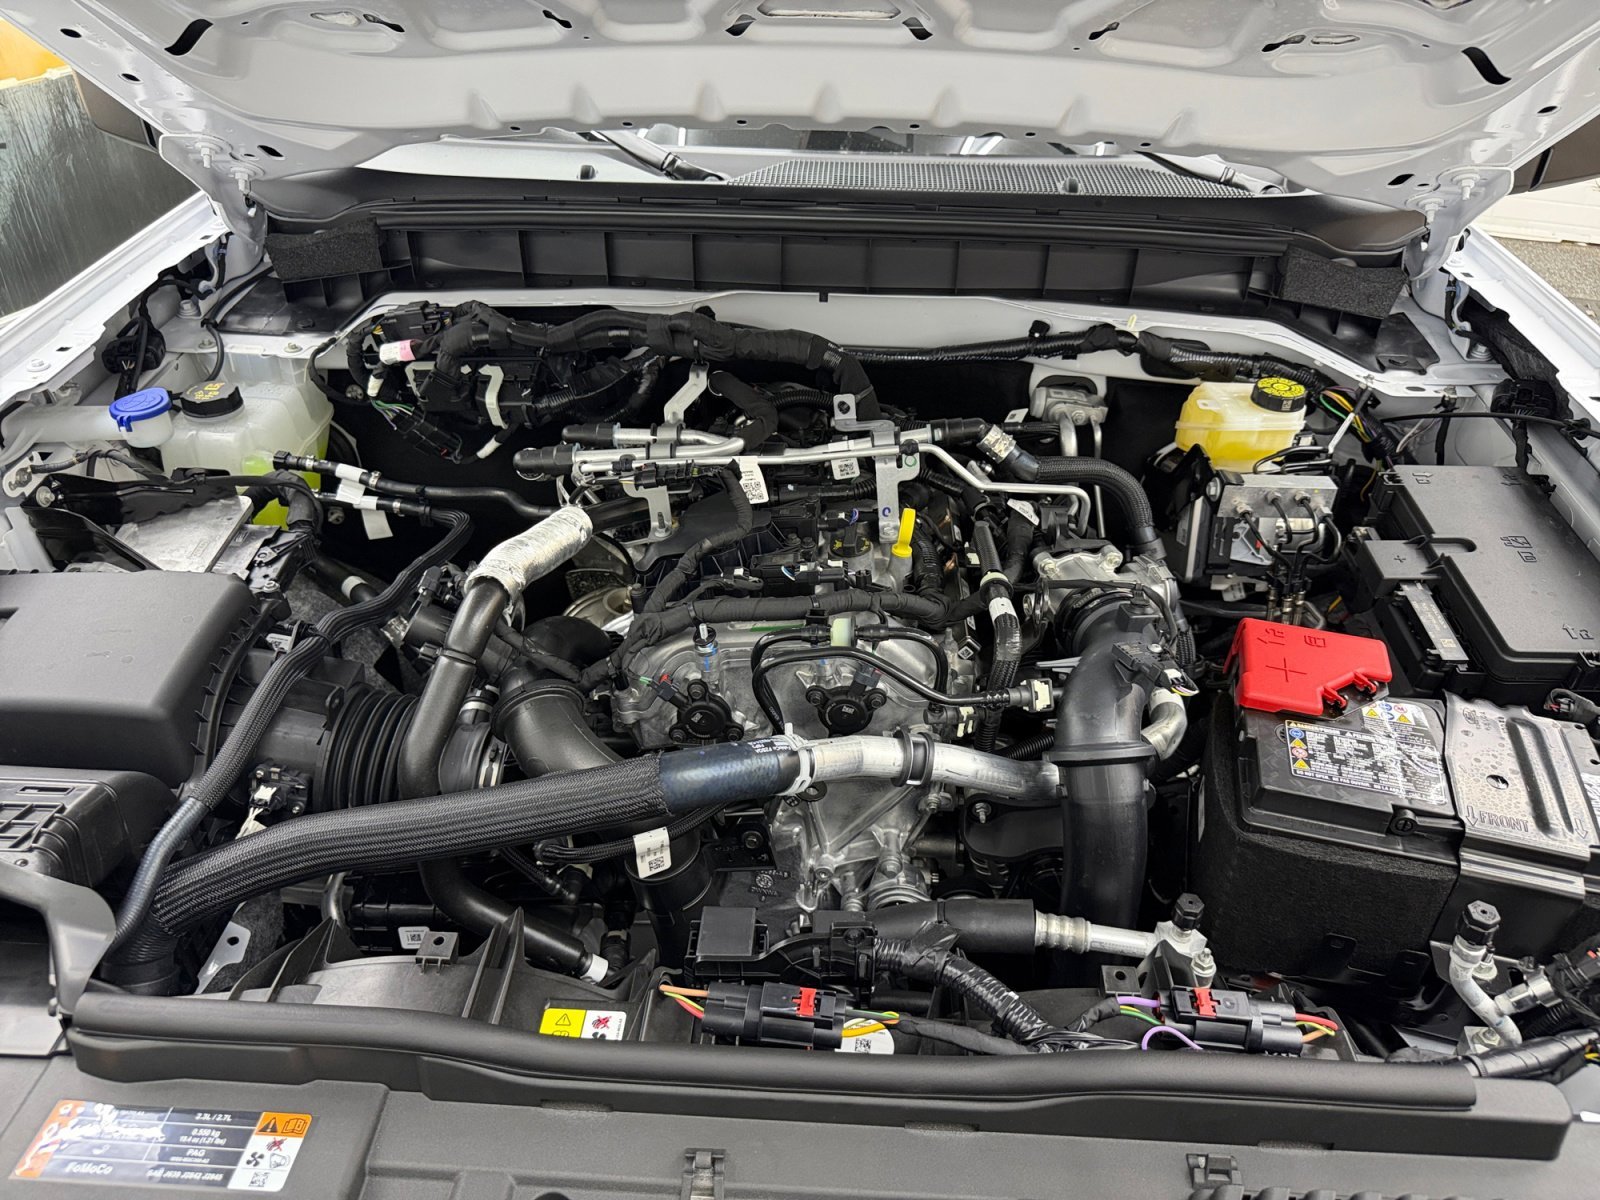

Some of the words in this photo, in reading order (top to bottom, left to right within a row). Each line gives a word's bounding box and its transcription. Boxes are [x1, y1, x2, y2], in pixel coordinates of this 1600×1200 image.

[1480, 810, 1528, 832] FRONT
[186, 1149, 206, 1157] PAG
[65, 1161, 113, 1174] FoMoCo
